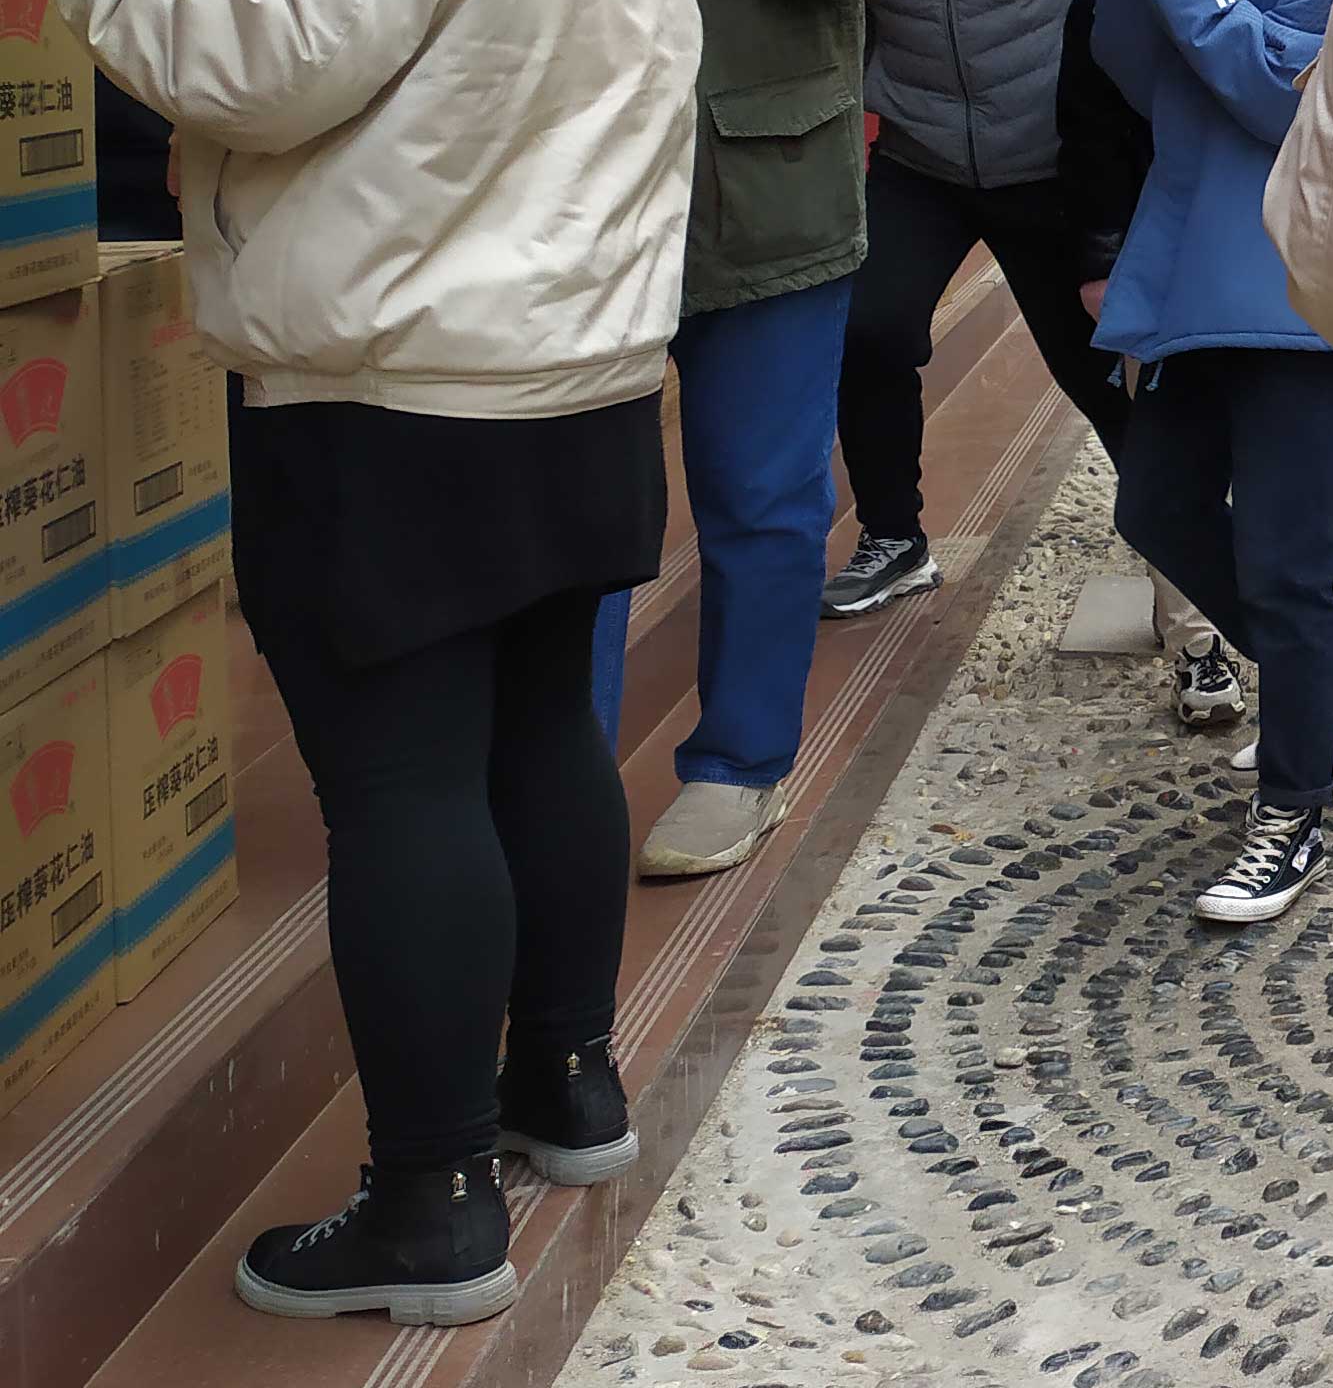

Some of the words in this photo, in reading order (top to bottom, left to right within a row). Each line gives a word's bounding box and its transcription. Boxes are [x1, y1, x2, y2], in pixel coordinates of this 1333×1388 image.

[0, 453, 86, 527] 榨葵花仁油
[142, 736, 219, 820] 压榨葵花仁油
